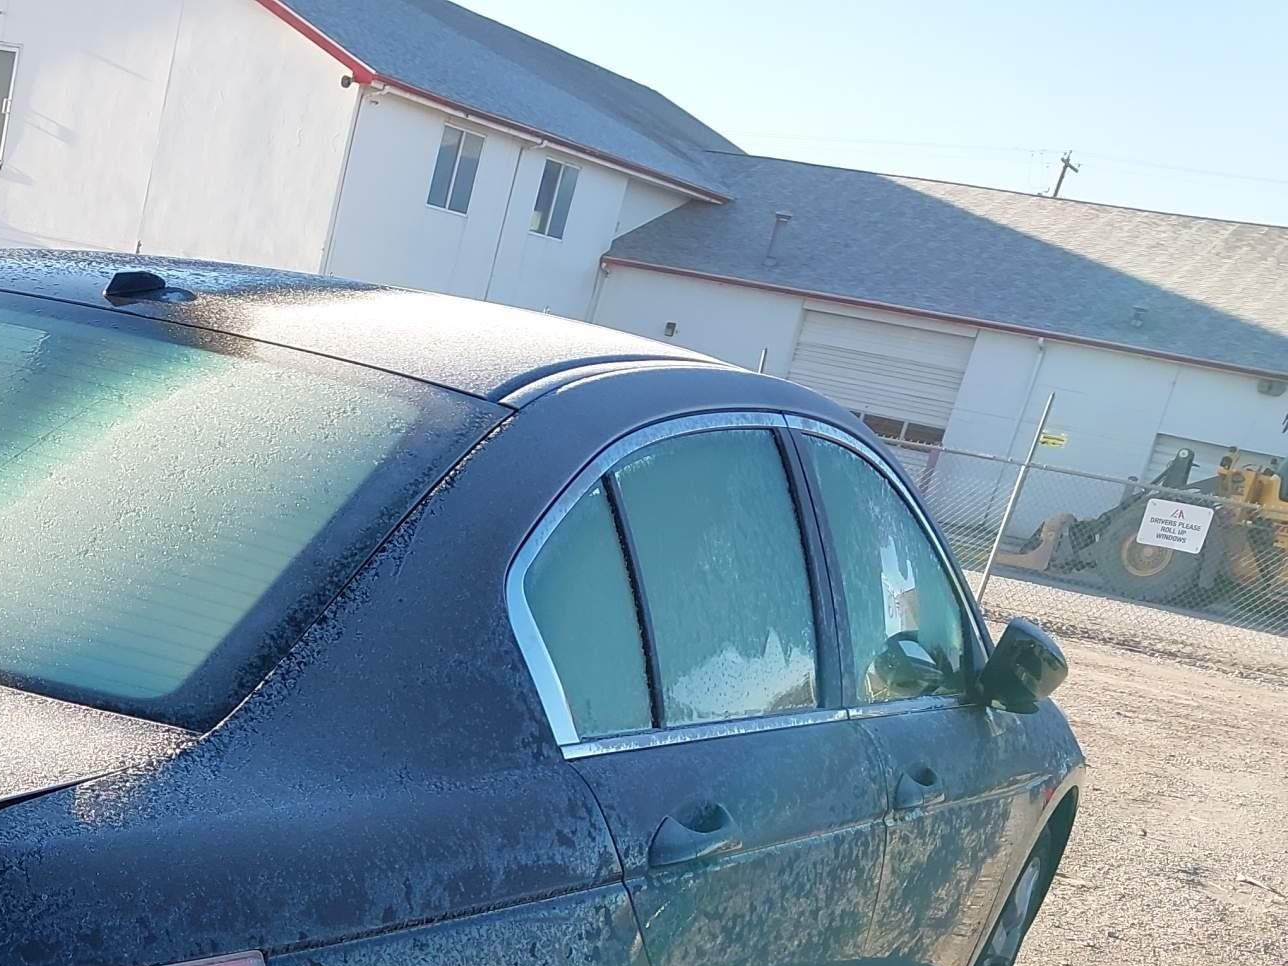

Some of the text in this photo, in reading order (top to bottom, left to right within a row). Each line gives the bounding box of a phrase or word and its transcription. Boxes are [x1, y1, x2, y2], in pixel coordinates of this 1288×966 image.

[1150, 516, 1201, 532] DRIVERS PLEASE
[1160, 526, 1187, 537] ROLL UP
[1156, 533, 1187, 544] WINDOWS
